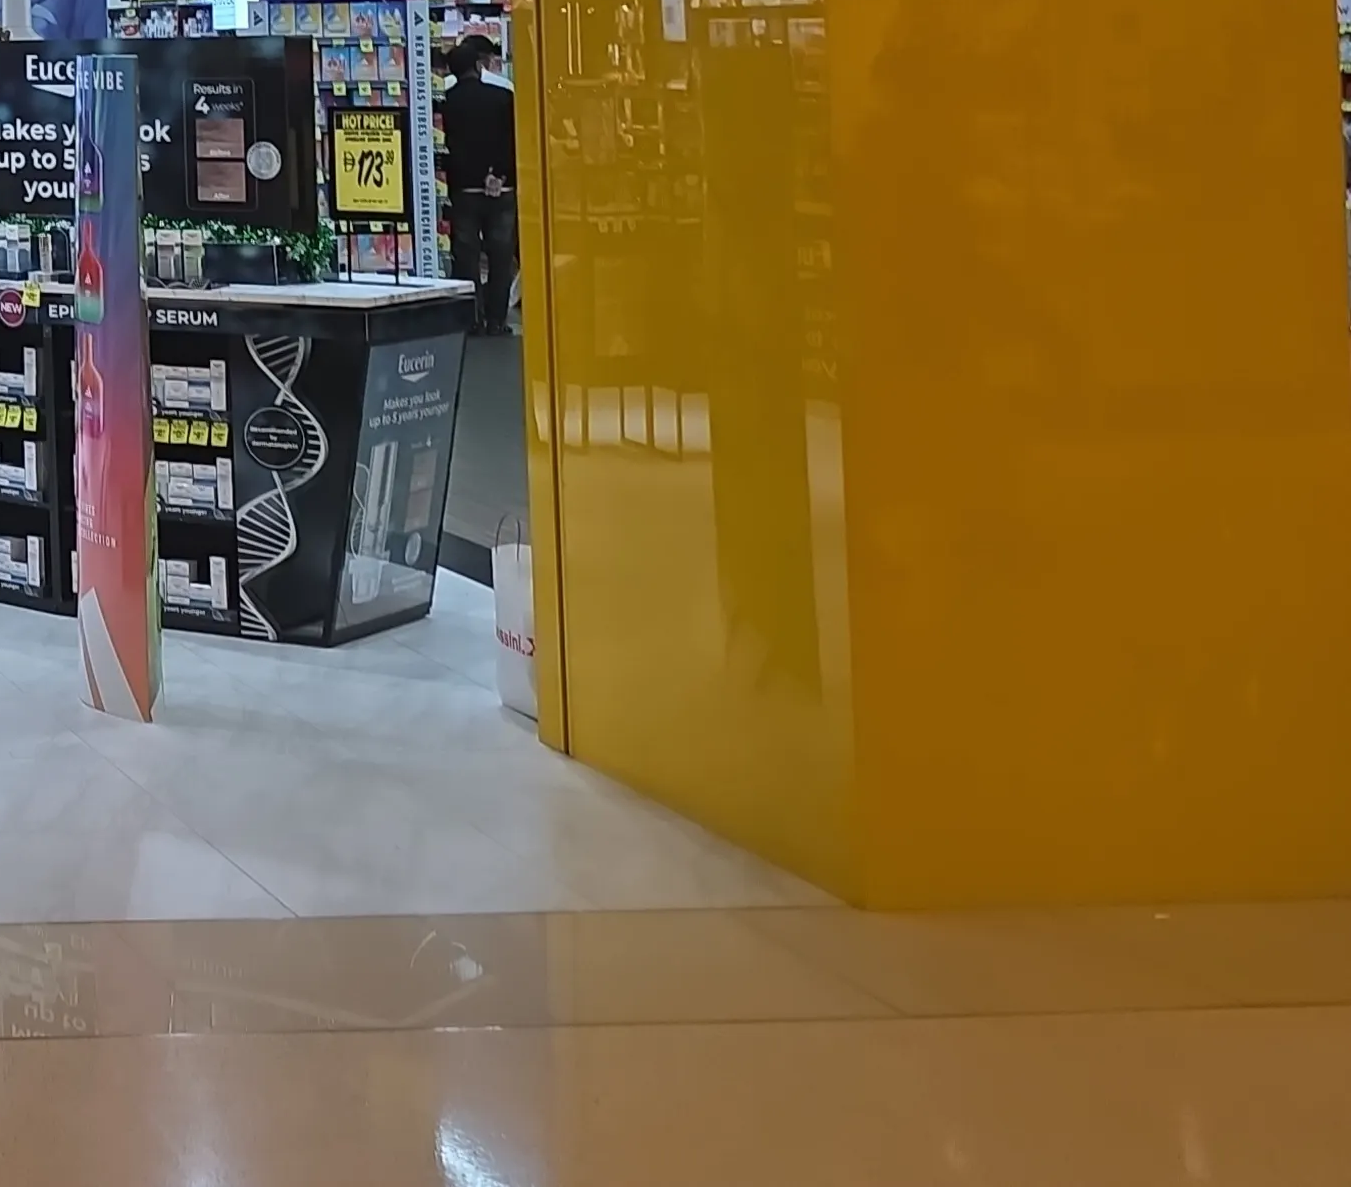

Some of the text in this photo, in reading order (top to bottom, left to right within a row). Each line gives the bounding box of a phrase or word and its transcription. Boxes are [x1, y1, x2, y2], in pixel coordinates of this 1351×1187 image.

[25, 54, 75, 81] Euce
[93, 70, 124, 91] VIBE
[193, 83, 243, 94] Results in
[195, 95, 211, 115] 4
[139, 118, 171, 142] ok
[342, 114, 394, 130] HOT PRICE!
[31, 149, 57, 170] to
[62, 148, 75, 170] 5
[0, 302, 22, 314] NEW
[156, 309, 218, 326] SERUM
[398, 350, 435, 374] Eucerin
